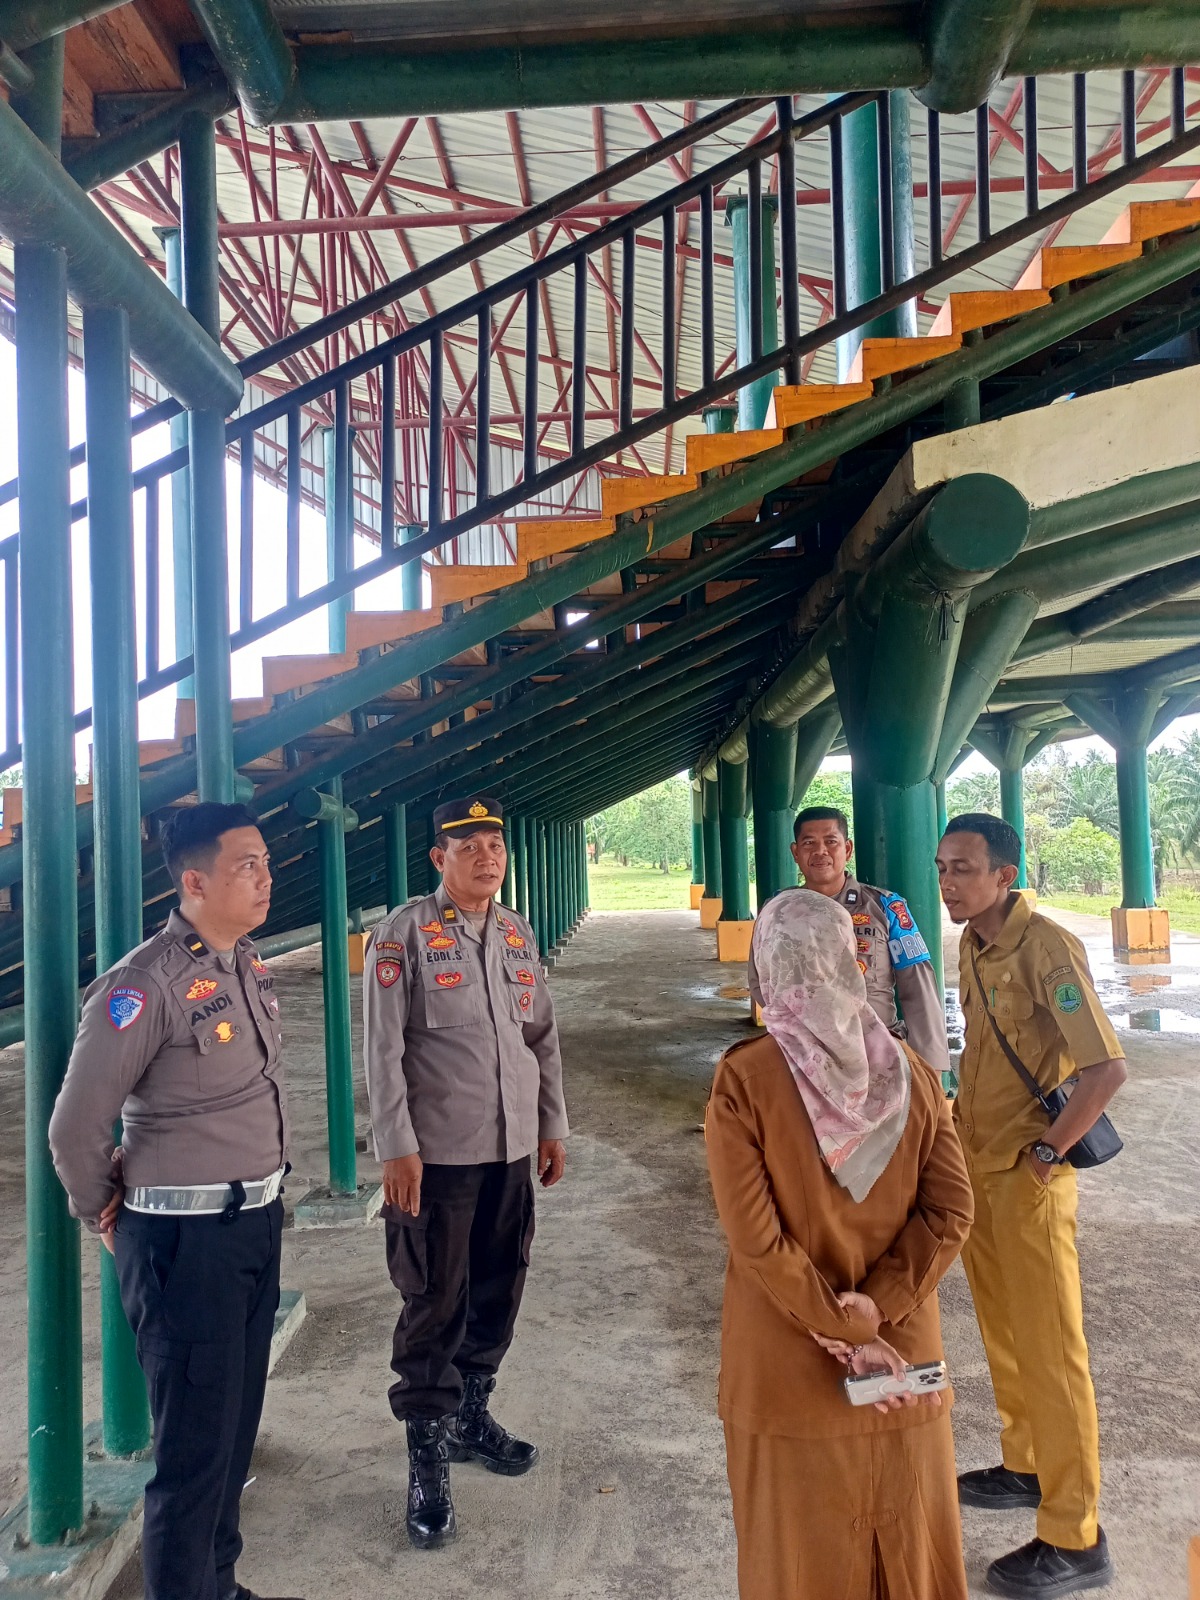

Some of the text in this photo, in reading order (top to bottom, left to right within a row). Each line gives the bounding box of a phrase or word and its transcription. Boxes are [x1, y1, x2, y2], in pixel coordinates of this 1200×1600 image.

[854, 927, 876, 936] LRI
[506, 949, 532, 961] POLRI
[191, 993, 232, 1027] ANDI
